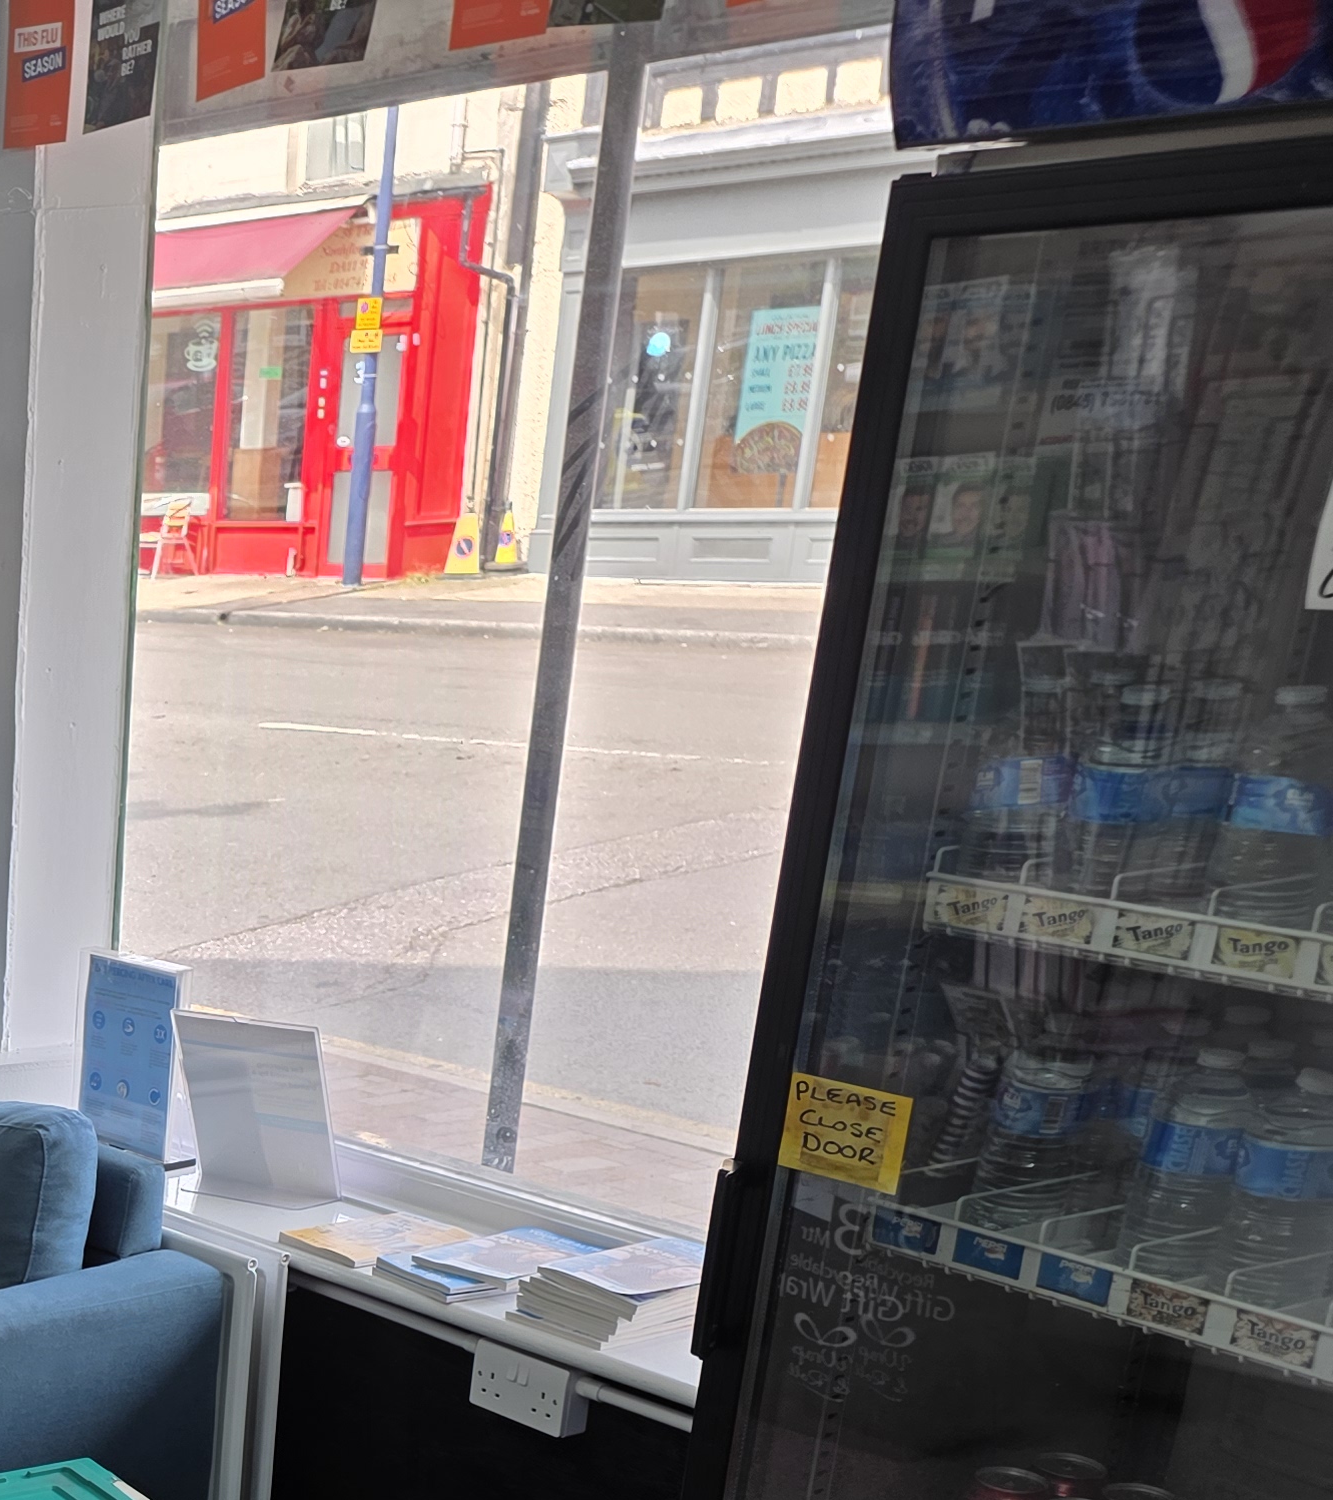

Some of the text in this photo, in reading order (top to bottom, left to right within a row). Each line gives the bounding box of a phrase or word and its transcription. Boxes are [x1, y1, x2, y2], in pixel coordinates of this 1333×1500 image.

[99, 5, 126, 25] WHERE
[17, 26, 59, 47] THIS FLU
[97, 21, 125, 41] WOULD
[123, 29, 140, 44] YOU
[122, 39, 152, 60] RATHER
[23, 52, 63, 79] SEASON
[121, 60, 135, 77] BE?
[753, 343, 817, 362] ANY PIZZA
[947, 895, 999, 916] Tango
[1036, 908, 1087, 928] Tango
[1129, 922, 1185, 943] Tango
[1231, 937, 1290, 955] Tango
[796, 1080, 896, 1117] PLEASE
[799, 1109, 883, 1144] CLOSE
[802, 1131, 877, 1165] DOOR
[1136, 1292, 1198, 1320] Tango
[1243, 1320, 1307, 1352] Tango
